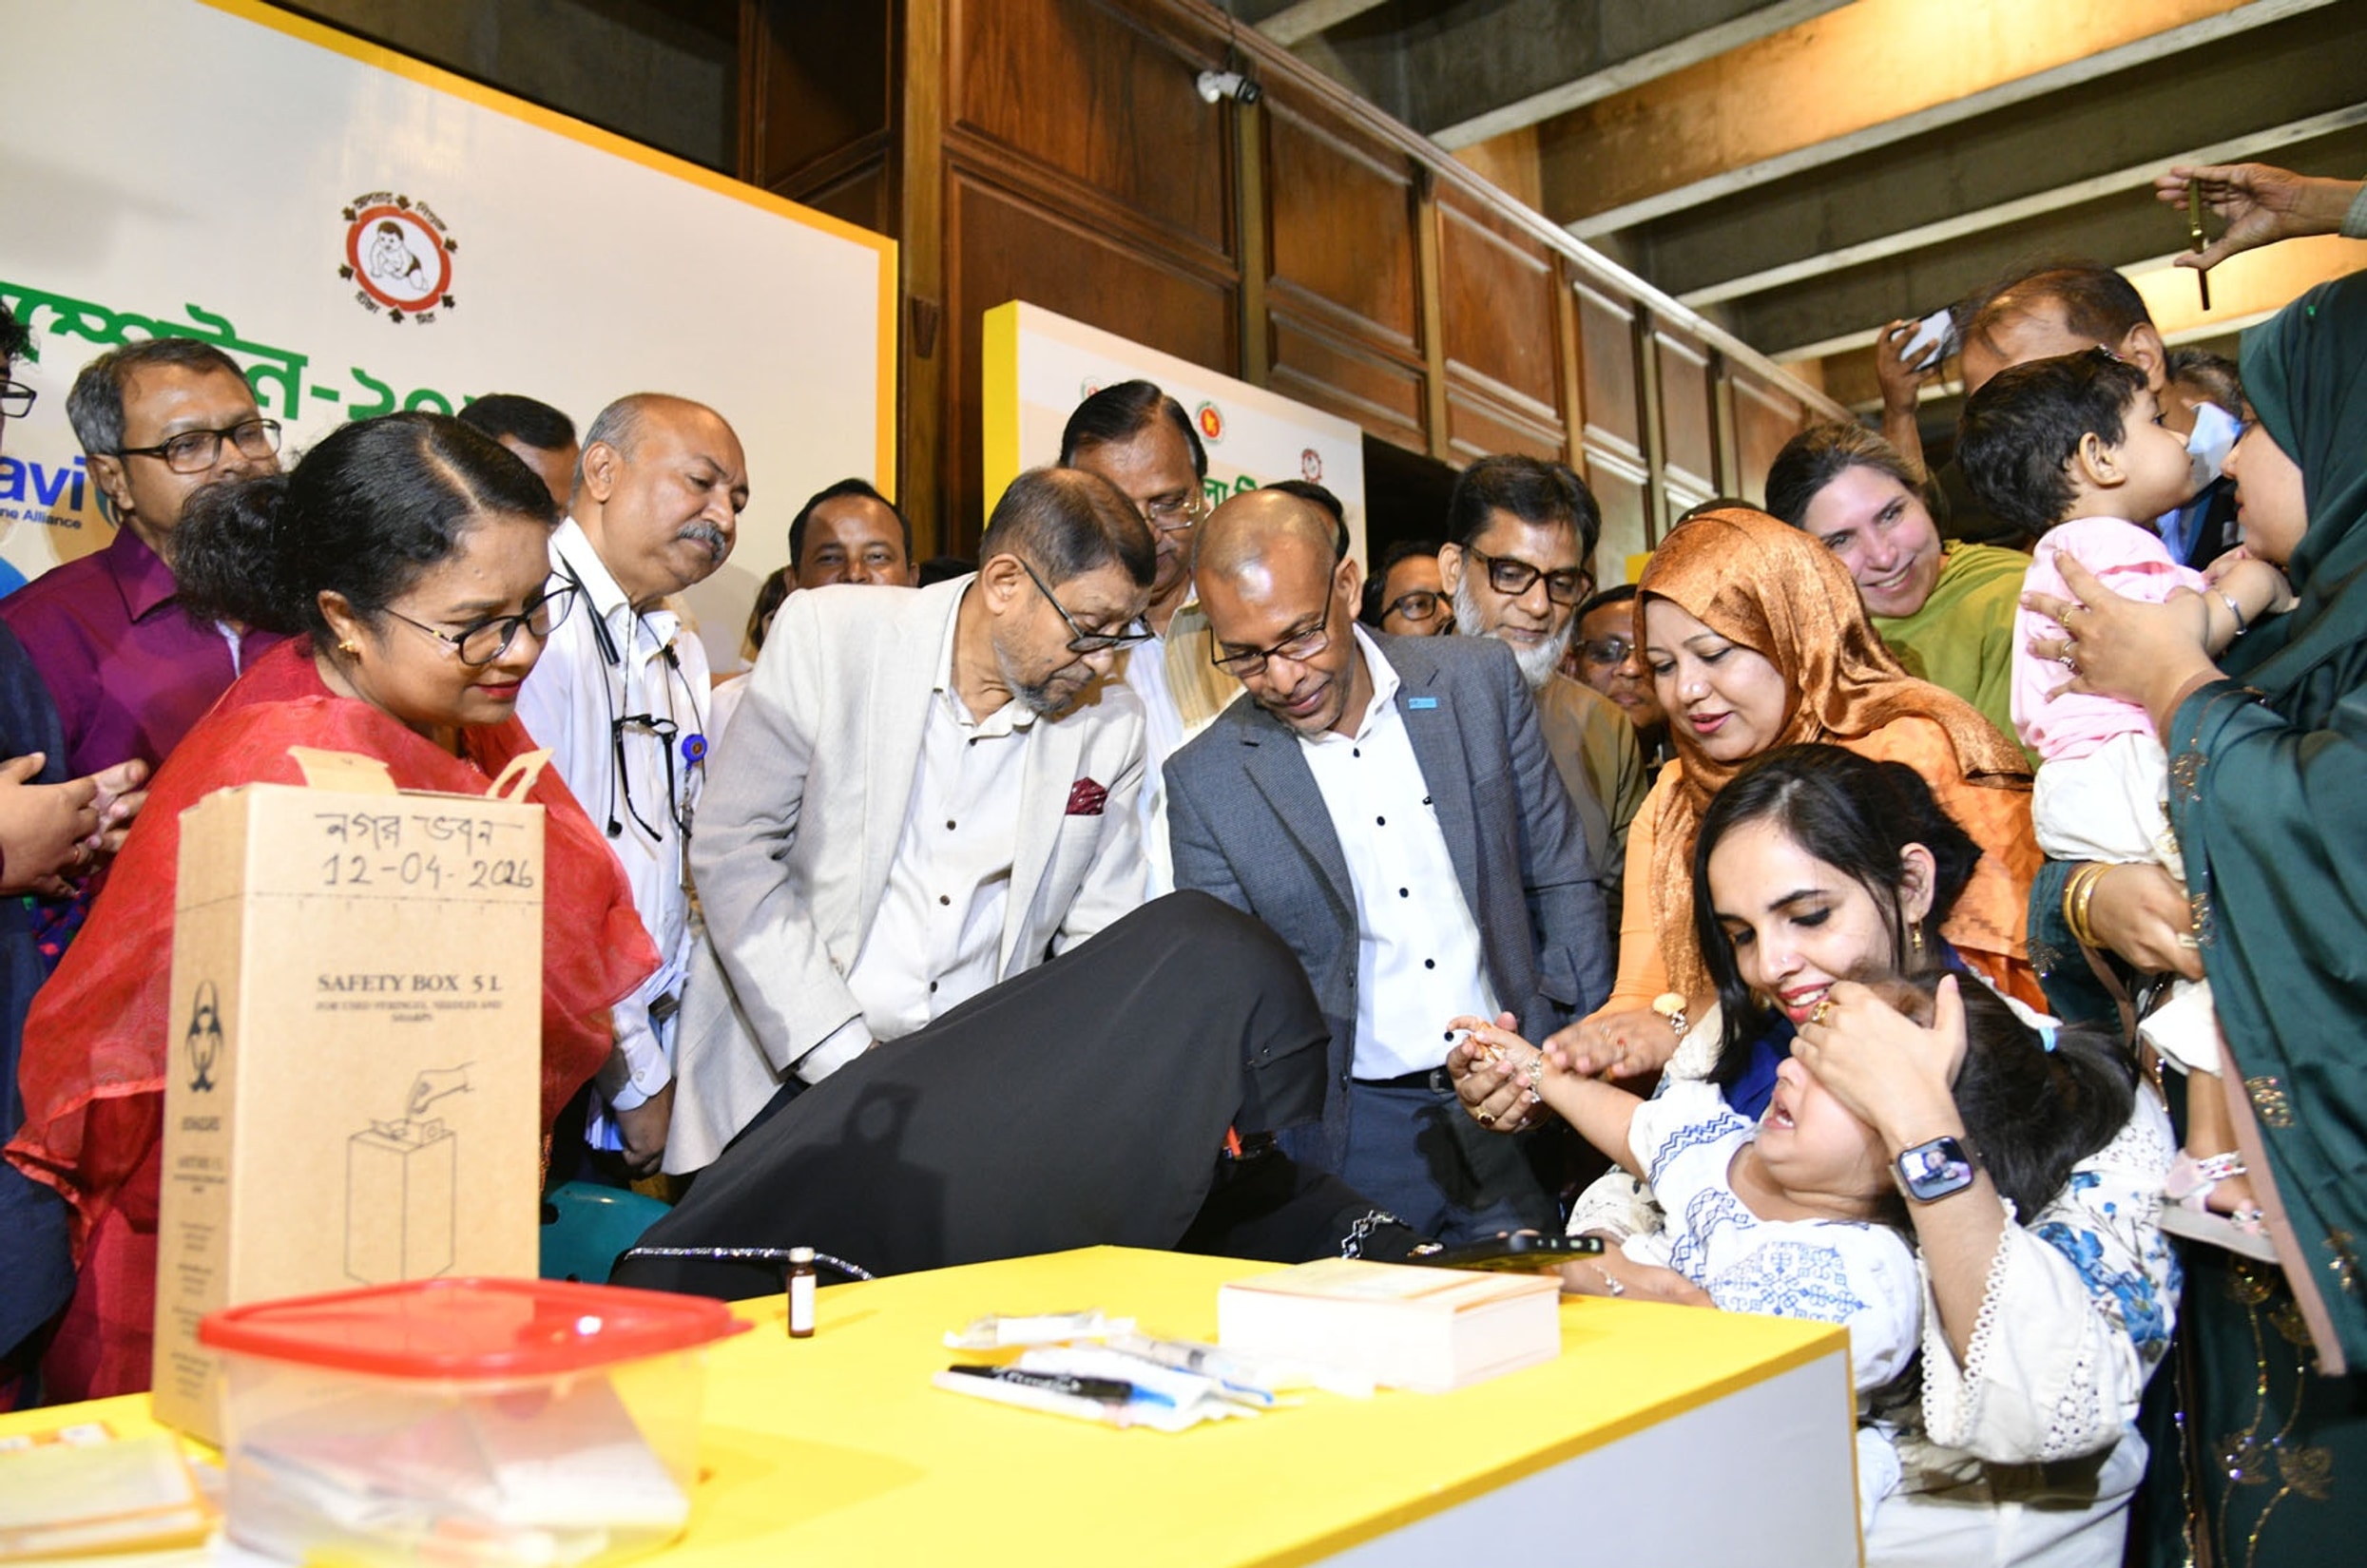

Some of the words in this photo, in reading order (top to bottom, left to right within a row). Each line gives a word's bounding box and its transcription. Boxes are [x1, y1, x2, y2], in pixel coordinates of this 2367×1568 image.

[0, 455, 87, 511] avi
[23, 508, 83, 529] Alliance
[318, 974, 404, 992] SAFETY
[412, 974, 459, 992] BOX
[472, 975, 484, 993] 5
[490, 975, 504, 992] L
